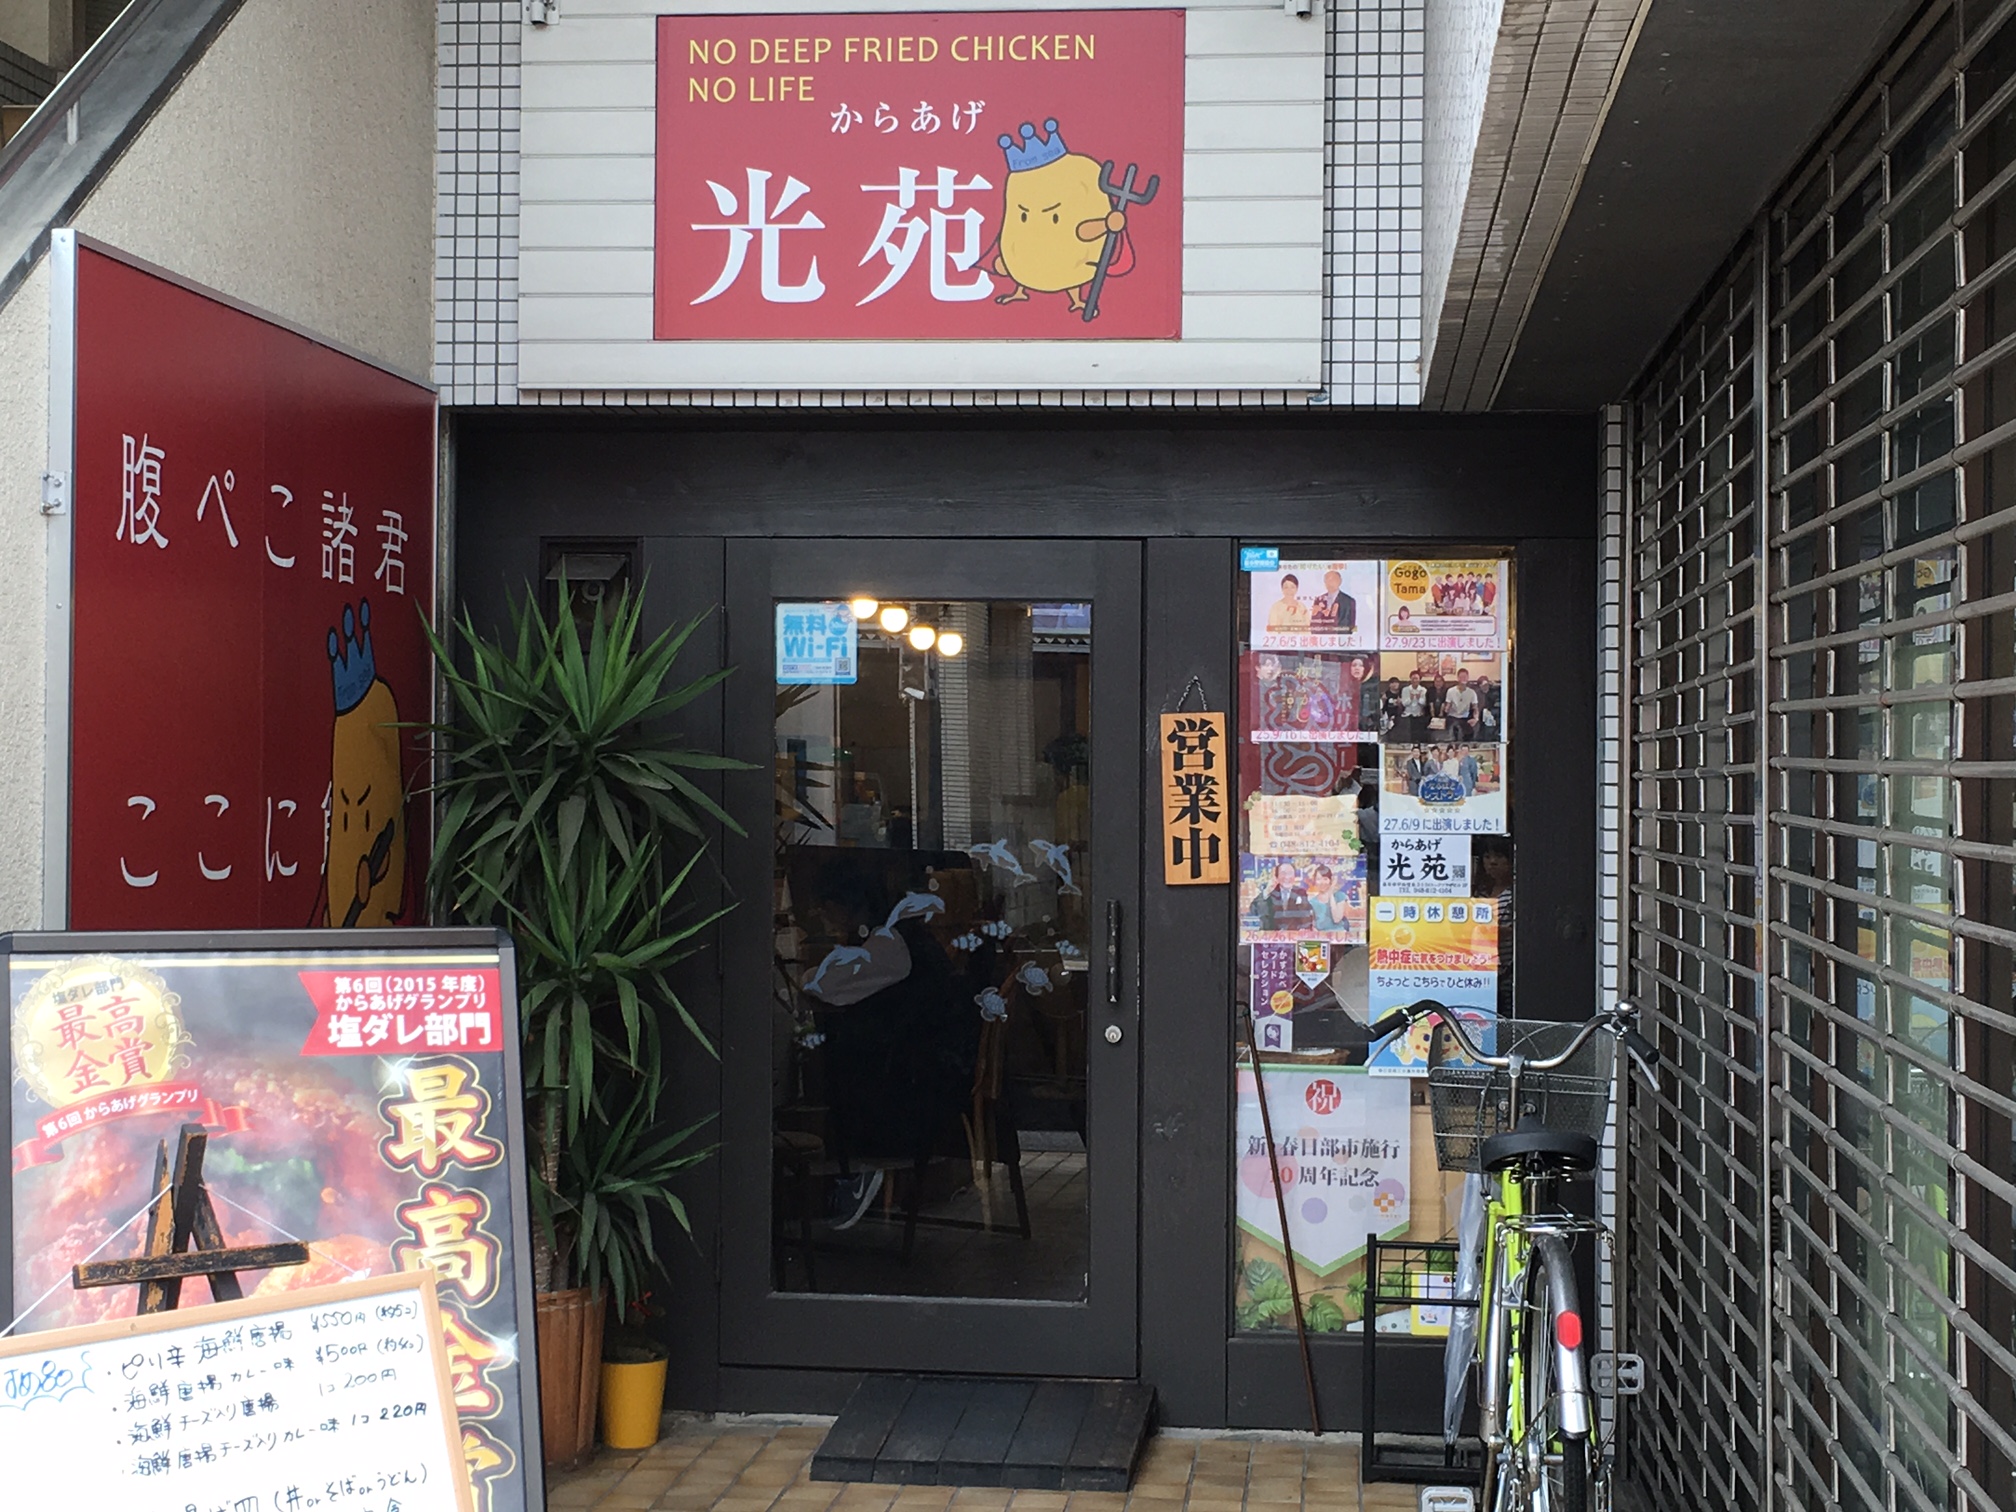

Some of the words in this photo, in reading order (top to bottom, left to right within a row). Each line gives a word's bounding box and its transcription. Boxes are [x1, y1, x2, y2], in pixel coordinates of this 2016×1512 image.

[688, 38, 737, 65] NO
[750, 37, 833, 63] DEEP
[844, 36, 939, 63] FRIED
[950, 34, 1095, 61] CHICKEN
[688, 77, 737, 102] NO
[749, 76, 815, 101] LIFE
[830, 100, 986, 135] からあげ
[690, 166, 994, 307] 光苑
[116, 433, 408, 595] 腹ぺこ諸君
[1394, 567, 1428, 580] Gogo
[1394, 583, 1426, 594] Tama
[783, 613, 826, 636] 無料
[783, 636, 848, 657] Wi-Fi
[1167, 718, 1221, 879] 営業中
[120, 780, 333, 887] ここに
[1384, 818, 1420, 831] 27.6/9
[1391, 838, 1442, 852] からあげ
[1386, 852, 1449, 881] 光苑
[1379, 905, 1489, 919] 一時休憩所
[336, 992, 486, 1012] からあげグランプリ
[51, 995, 147, 1051] 最高
[328, 1012, 492, 1048] 塩ダレ部門
[63, 1037, 155, 1095] 金賞
[1307, 1080, 1338, 1113] 祝
[386, 1064, 499, 1512] 最高金
